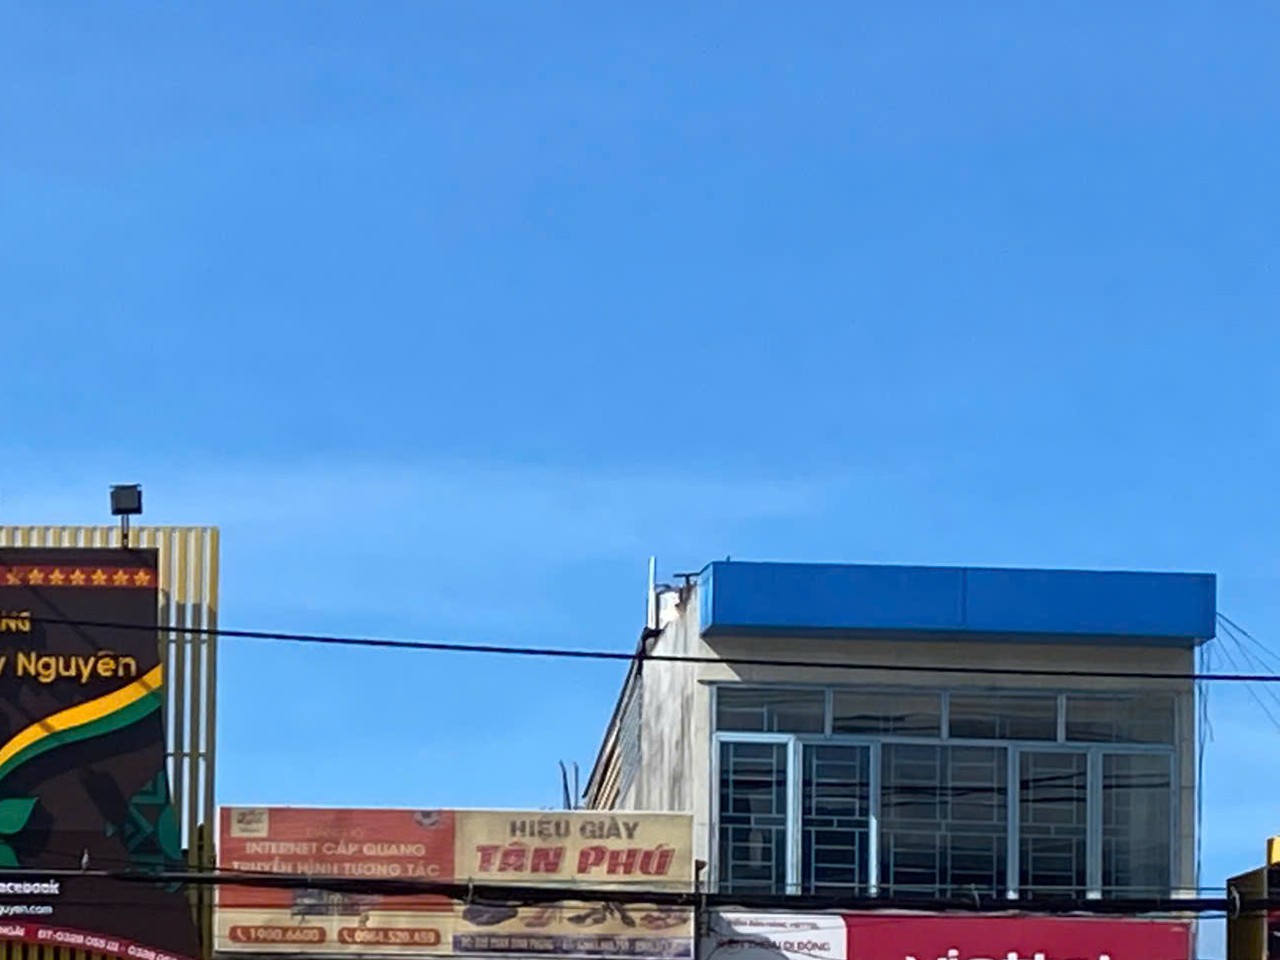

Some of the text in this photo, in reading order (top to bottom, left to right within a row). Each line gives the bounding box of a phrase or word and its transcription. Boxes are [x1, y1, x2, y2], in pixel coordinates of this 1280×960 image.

[17, 651, 137, 684] Nguyên
[509, 815, 640, 841] HIỆU GIÀY
[362, 843, 427, 858] QUANG
[476, 840, 676, 876] TÂN PHÚ
